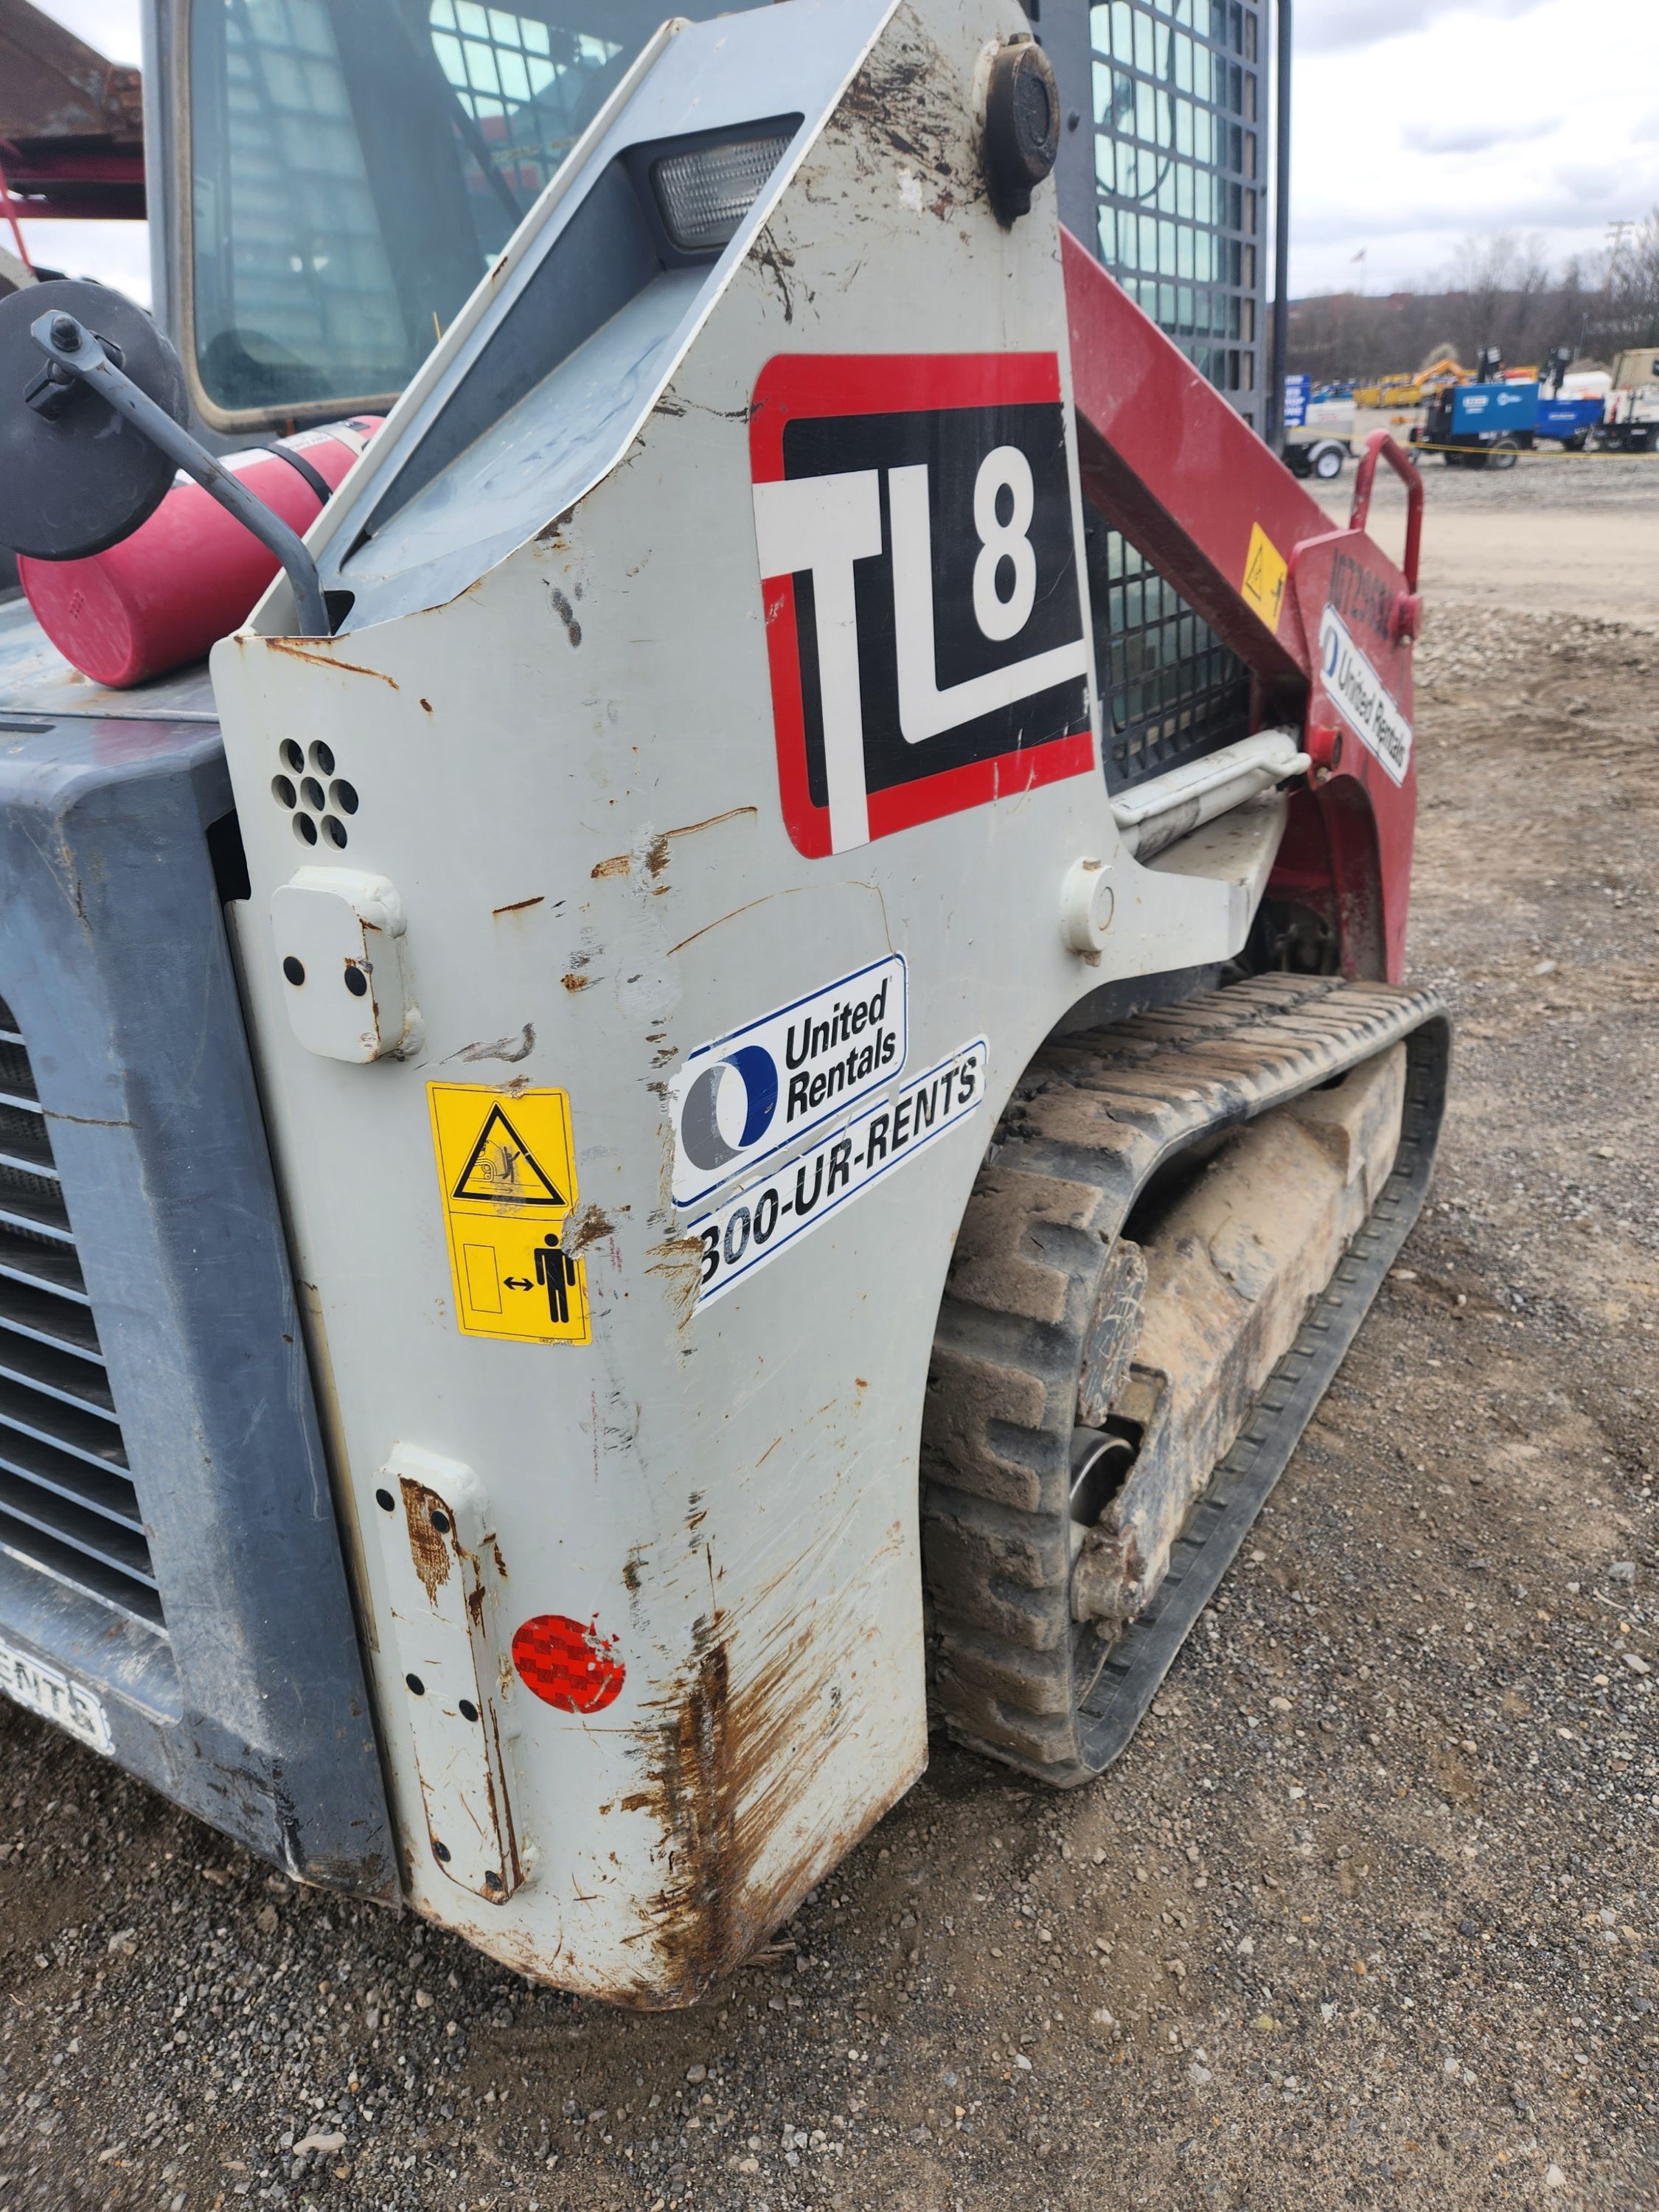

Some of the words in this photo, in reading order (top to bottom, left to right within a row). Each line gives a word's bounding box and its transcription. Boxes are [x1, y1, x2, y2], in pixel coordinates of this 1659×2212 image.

[752, 445, 1088, 855] TL8
[1338, 648, 1377, 726] United
[1371, 700, 1405, 768] Rentals
[785, 978, 888, 1071] United
[786, 1027, 897, 1123] Rentals
